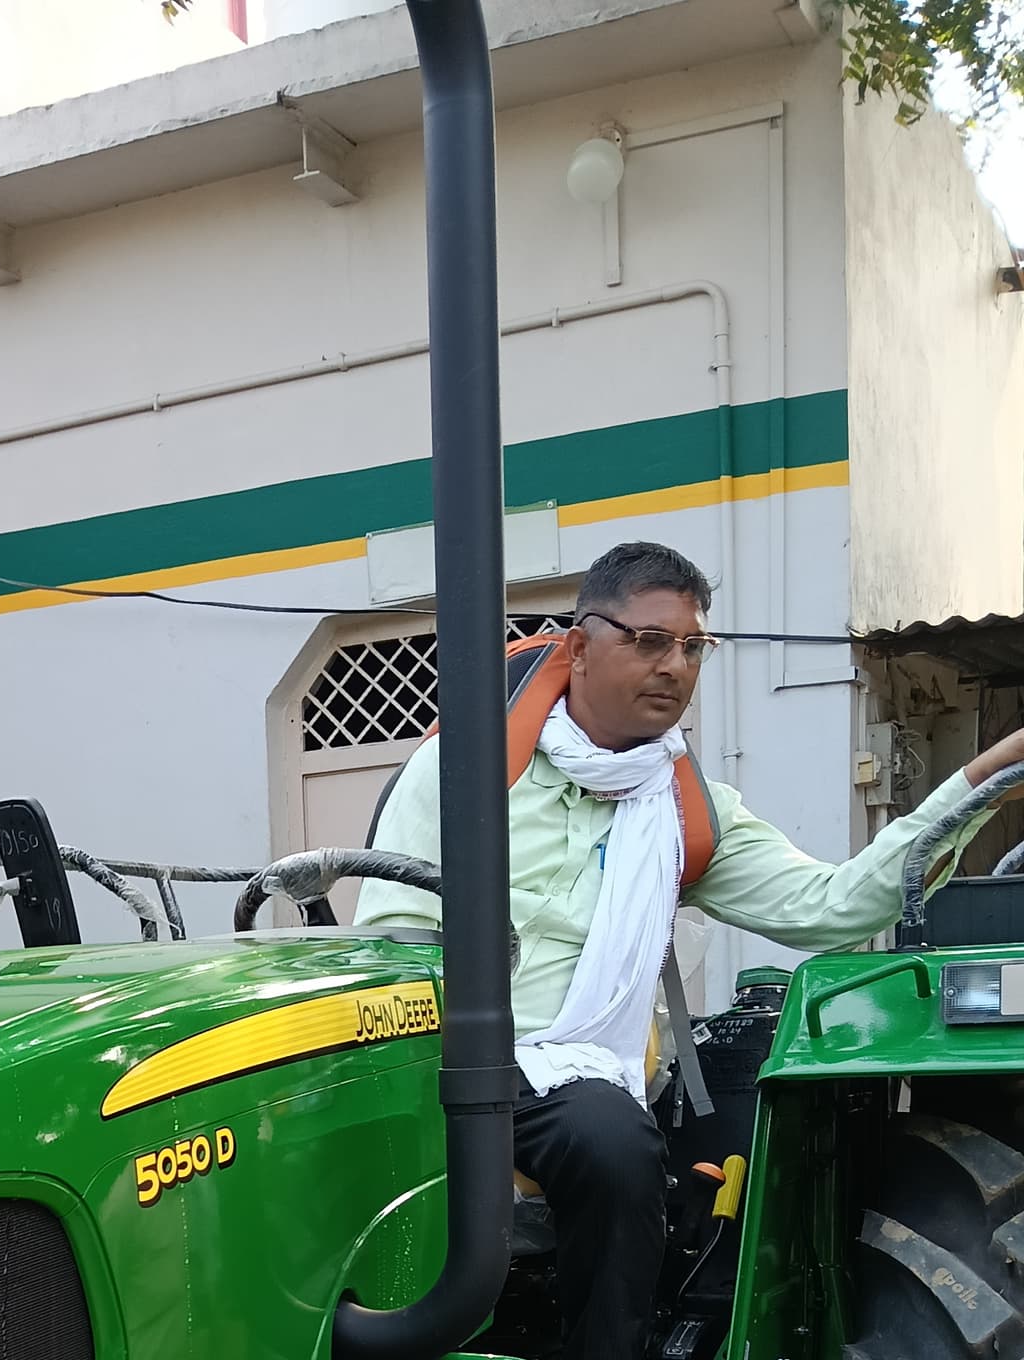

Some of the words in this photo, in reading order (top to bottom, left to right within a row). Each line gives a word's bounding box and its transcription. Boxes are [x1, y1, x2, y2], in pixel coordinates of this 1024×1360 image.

[356, 997, 394, 1040] JOHN
[394, 994, 435, 1033] DEERE
[135, 1132, 212, 1208] 5050
[216, 1127, 236, 1169] D
